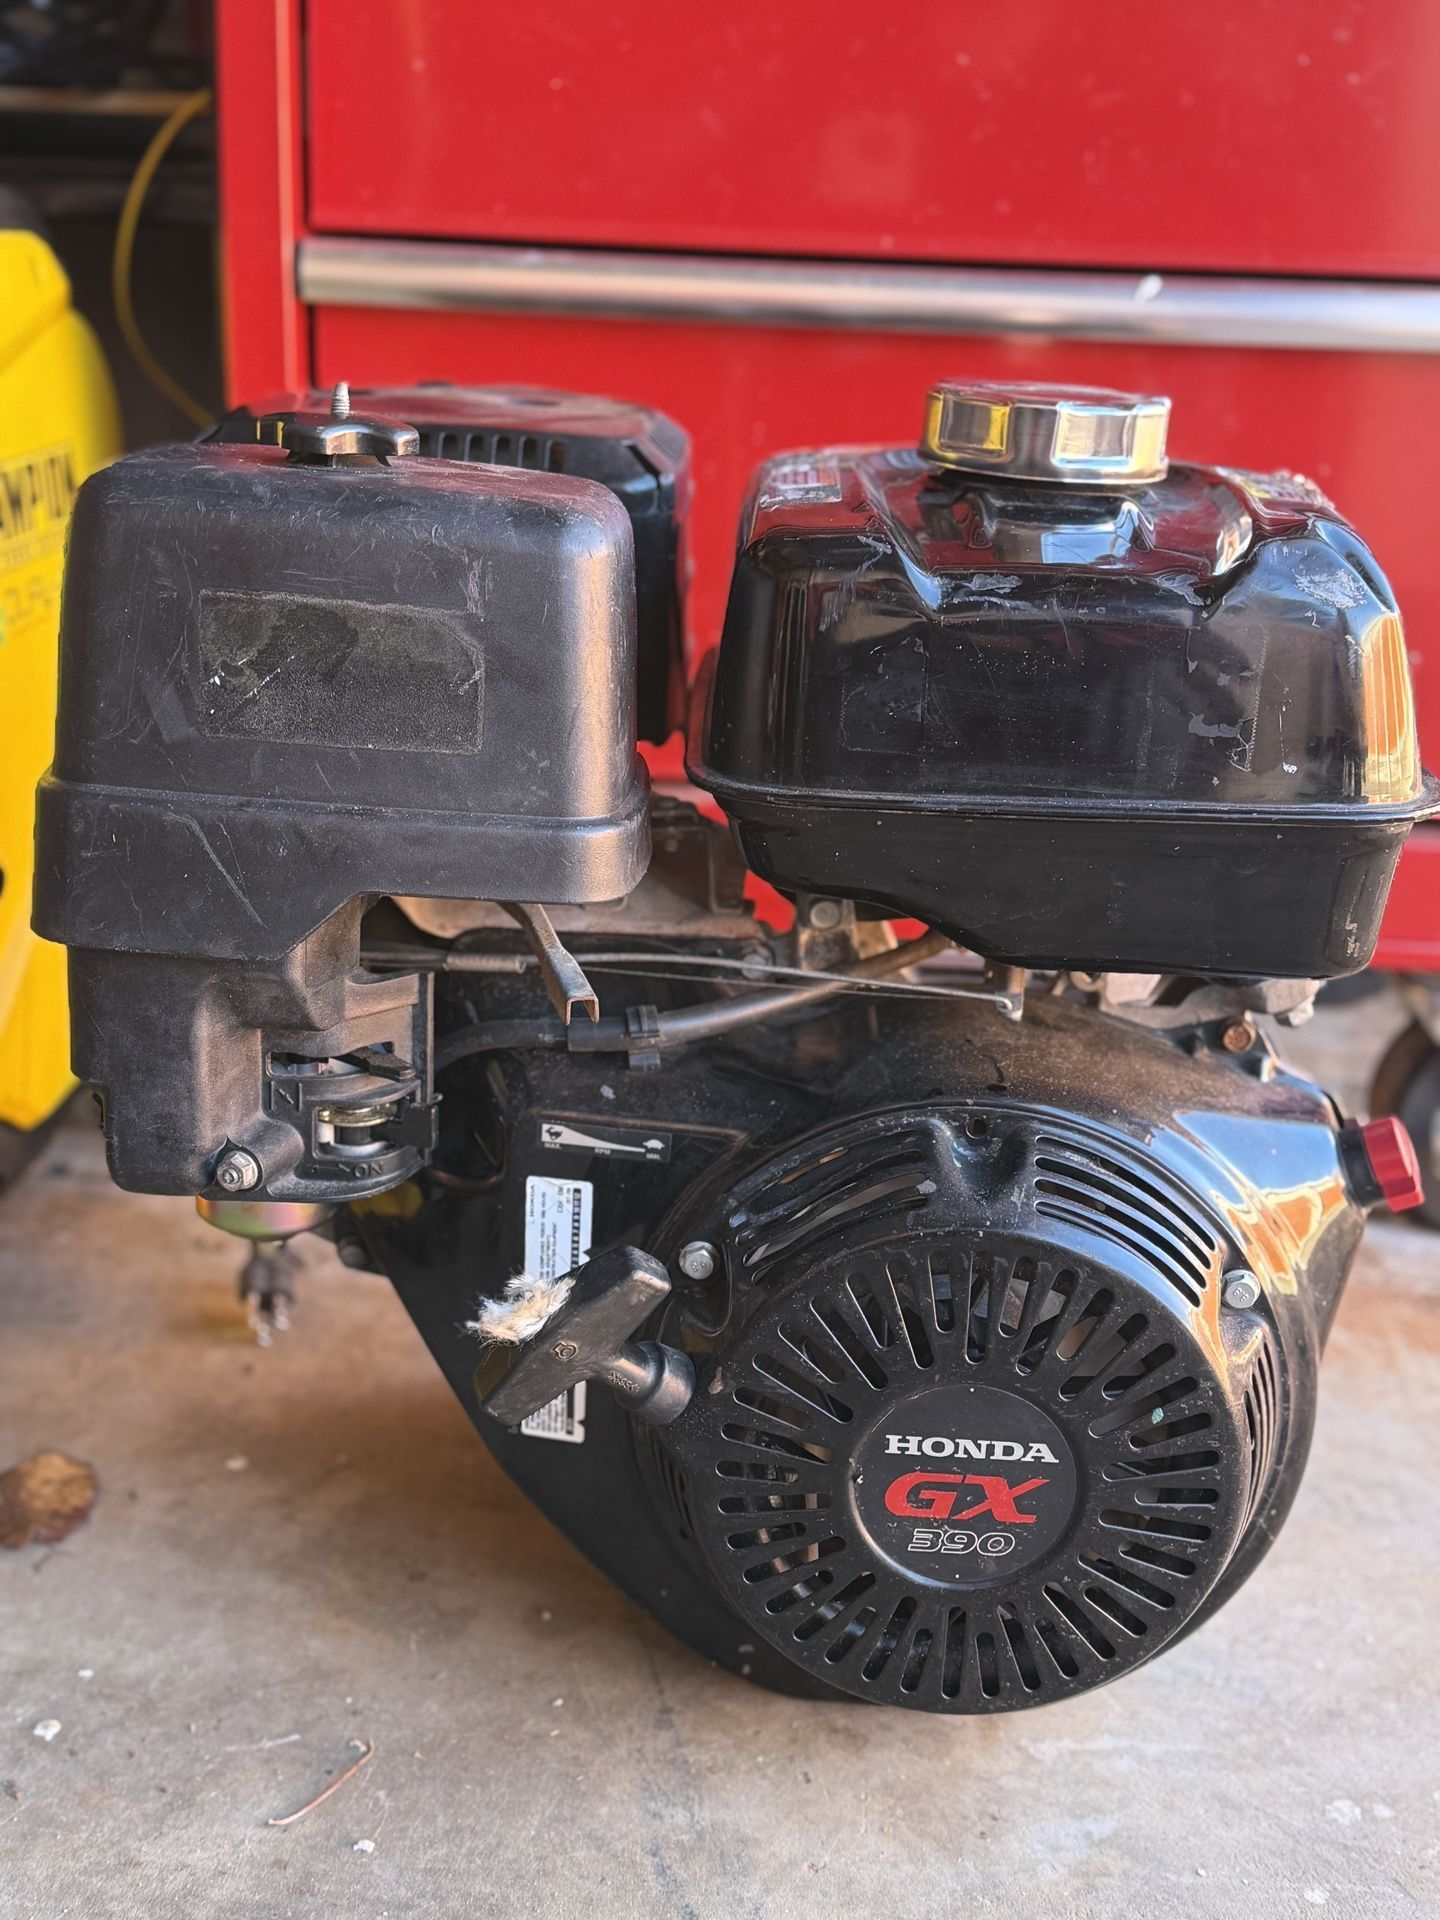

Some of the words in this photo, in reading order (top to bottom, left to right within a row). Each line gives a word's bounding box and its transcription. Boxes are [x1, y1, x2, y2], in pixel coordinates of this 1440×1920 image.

[354, 1160, 384, 1178] ON
[884, 1434, 1060, 1464] HONDA
[884, 1472, 1051, 1524] GX
[907, 1528, 1016, 1557] 390
